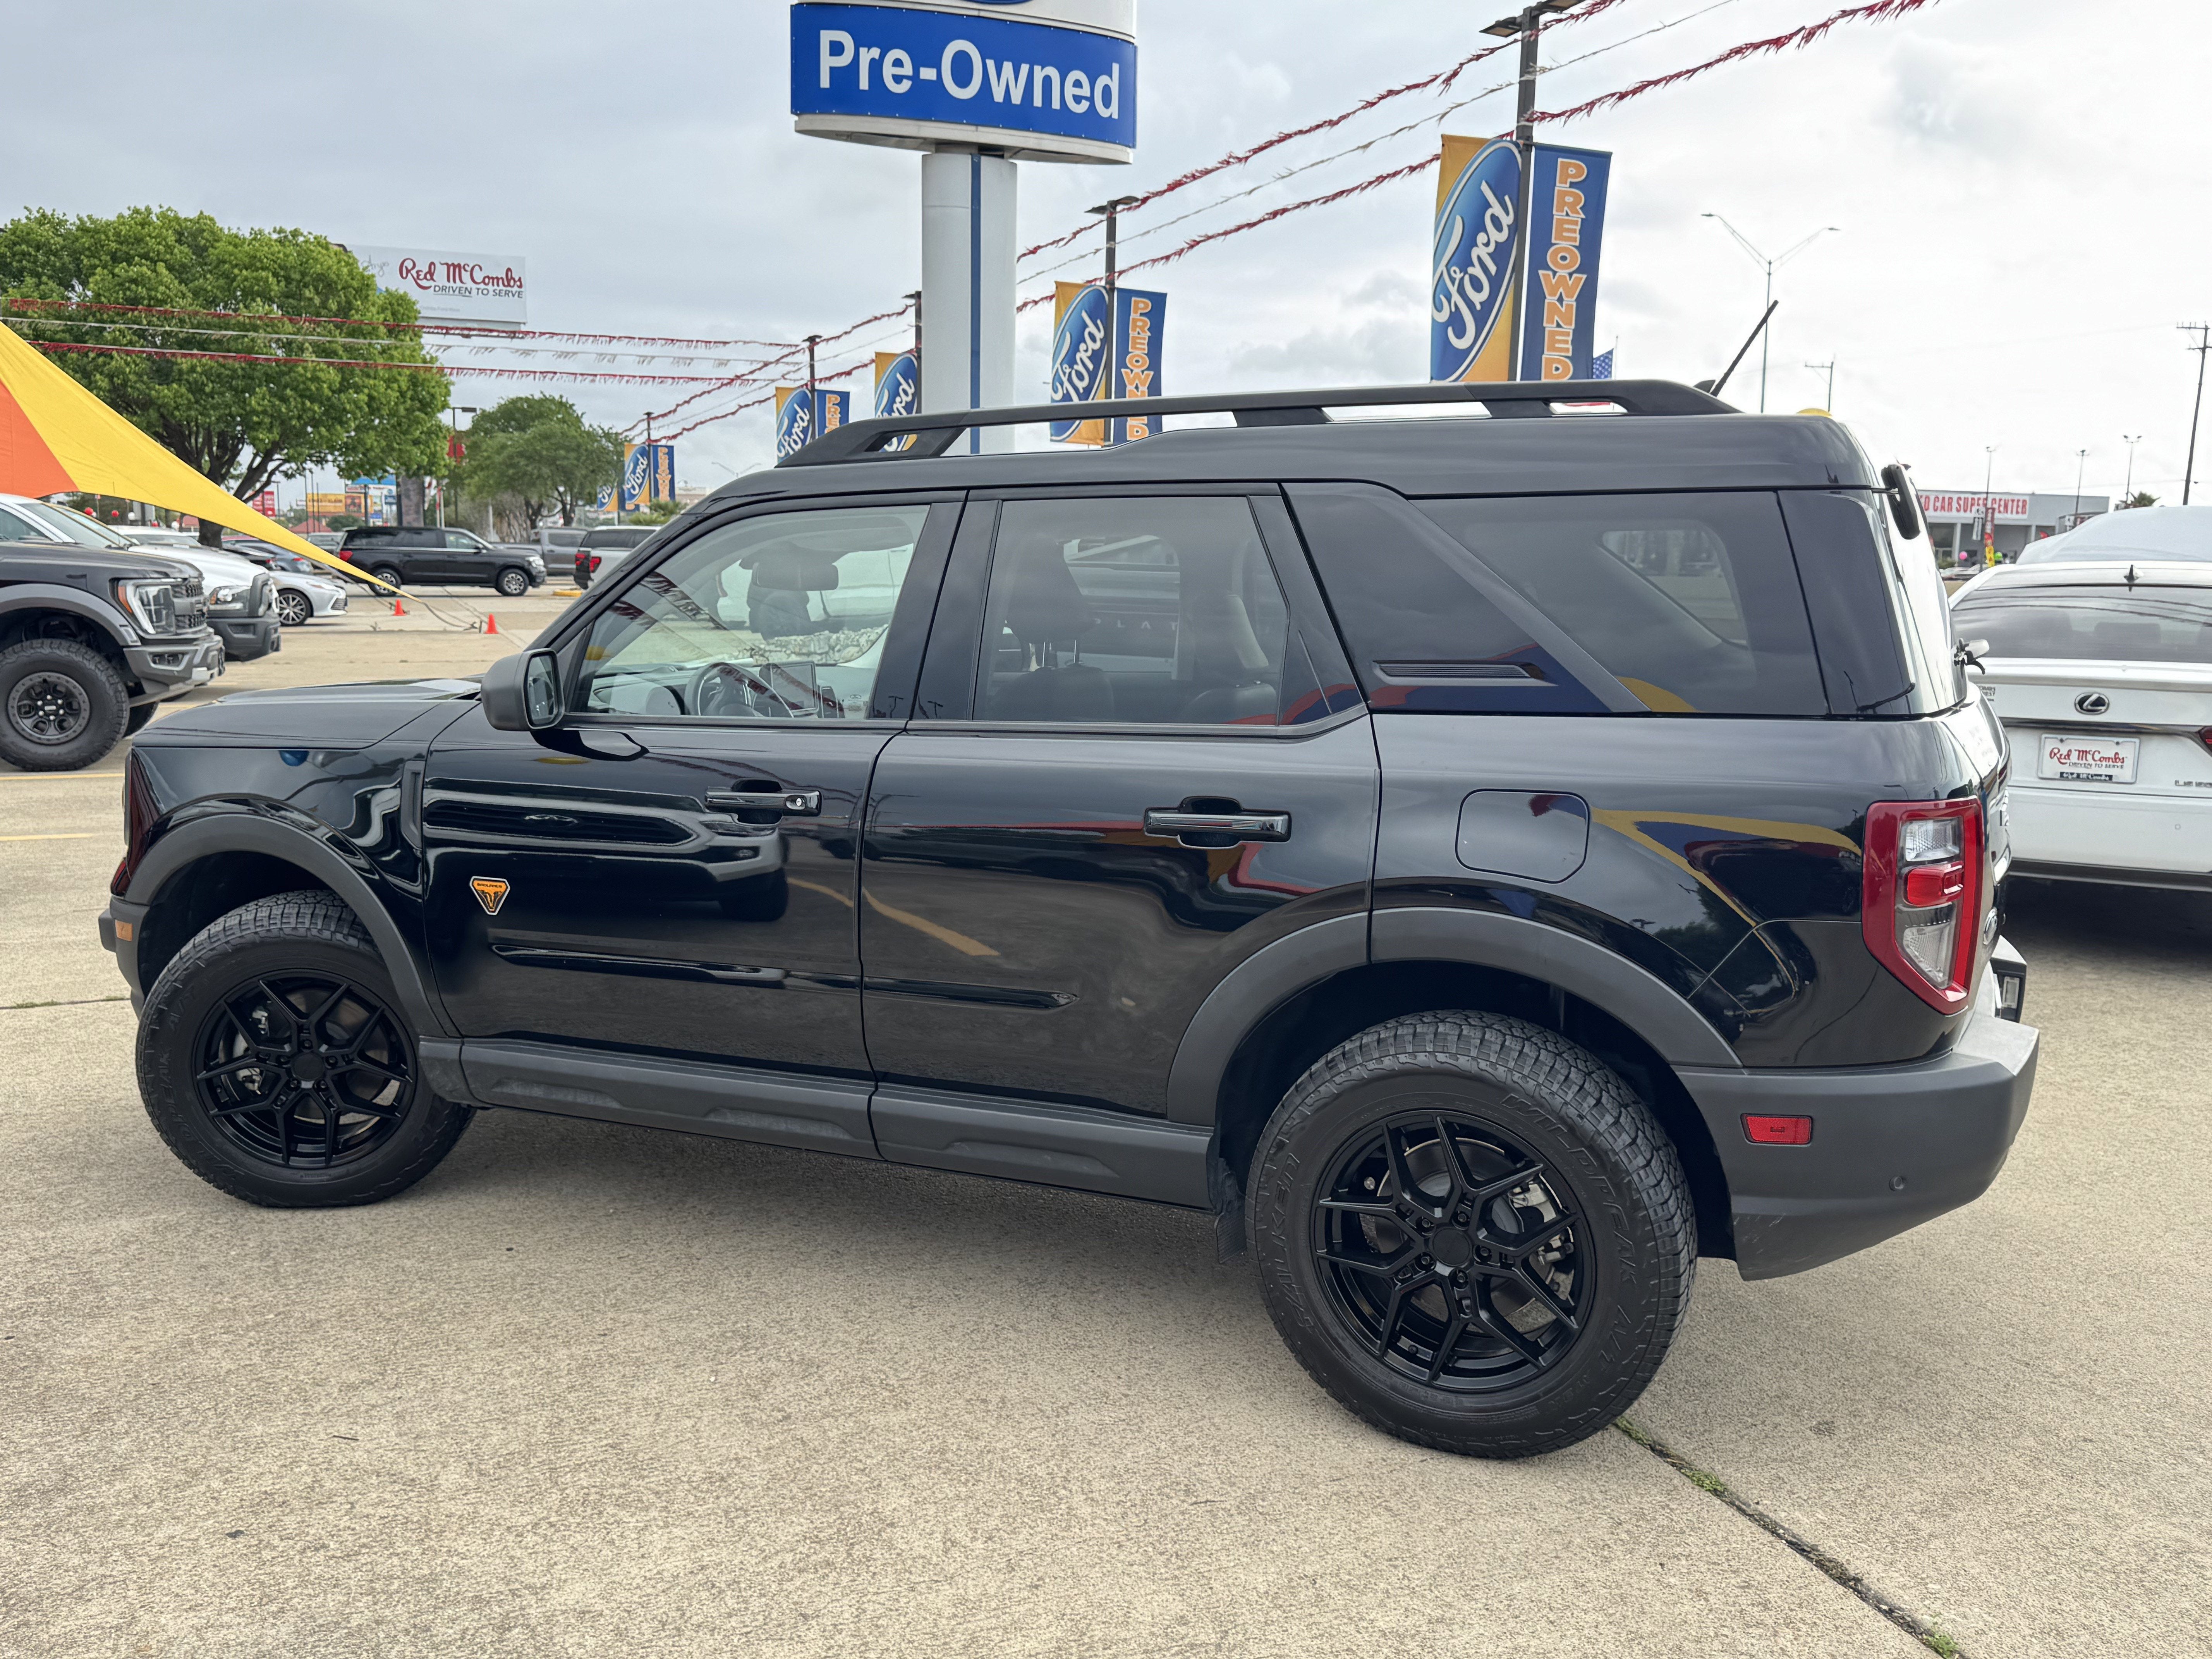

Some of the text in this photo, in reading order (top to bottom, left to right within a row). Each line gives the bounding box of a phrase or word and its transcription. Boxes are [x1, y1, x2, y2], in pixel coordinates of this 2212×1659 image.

[819, 30, 1120, 120] Pre-Owned
[398, 258, 436, 290] Red
[433, 285, 524, 298] DRIVEN TO SERVE
[1432, 180, 1514, 349] Ford
[1538, 157, 1587, 382] PREOWNED
[1051, 309, 1104, 402] Ford
[777, 403, 810, 457] Ford
[622, 454, 648, 495] Ford
[1933, 495, 1953, 513] CAR
[1991, 498, 2028, 515] CENTER
[2049, 747, 2072, 765] Red
[1271, 1153, 1314, 1327] FALKEN
